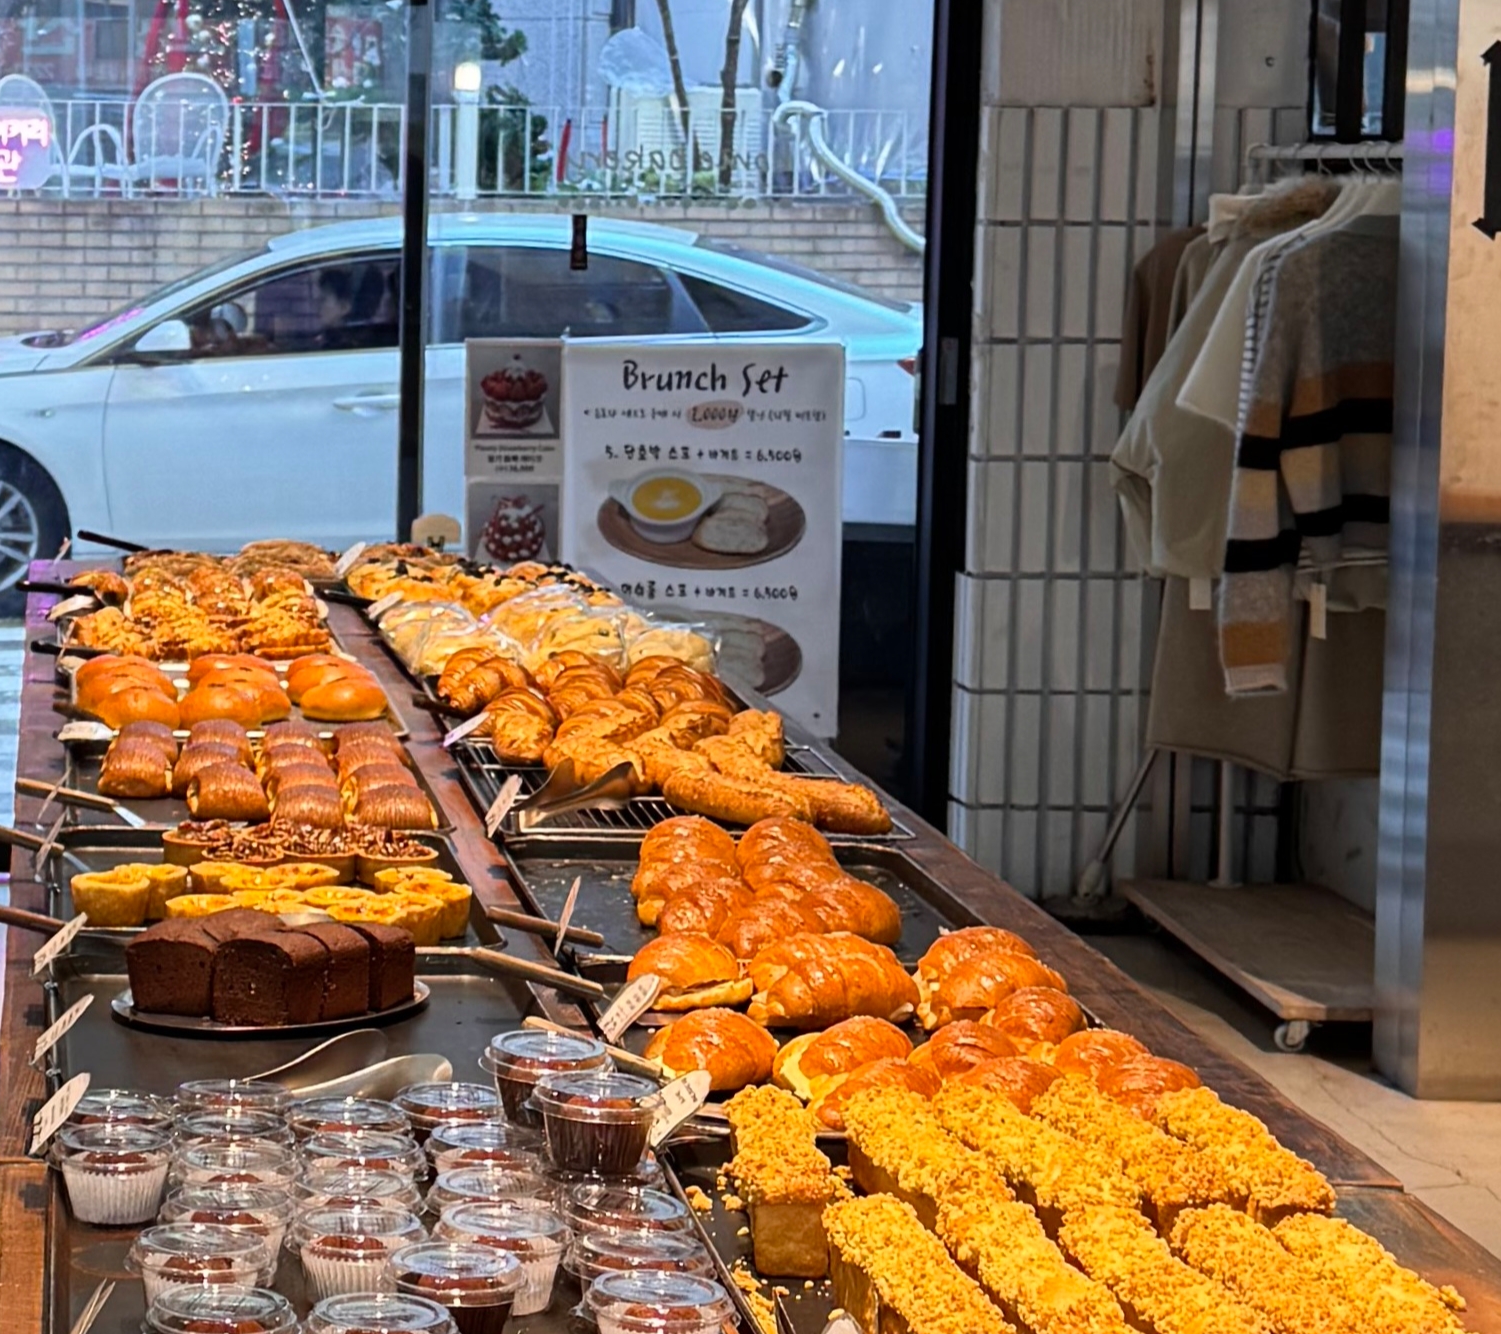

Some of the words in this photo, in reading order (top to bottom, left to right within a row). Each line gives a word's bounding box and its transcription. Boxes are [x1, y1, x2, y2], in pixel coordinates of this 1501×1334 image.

[622, 360, 726, 392] Brunch
[742, 363, 789, 397] Set
[668, 446, 690, 460] 스프
[665, 583, 687, 597] 스프
